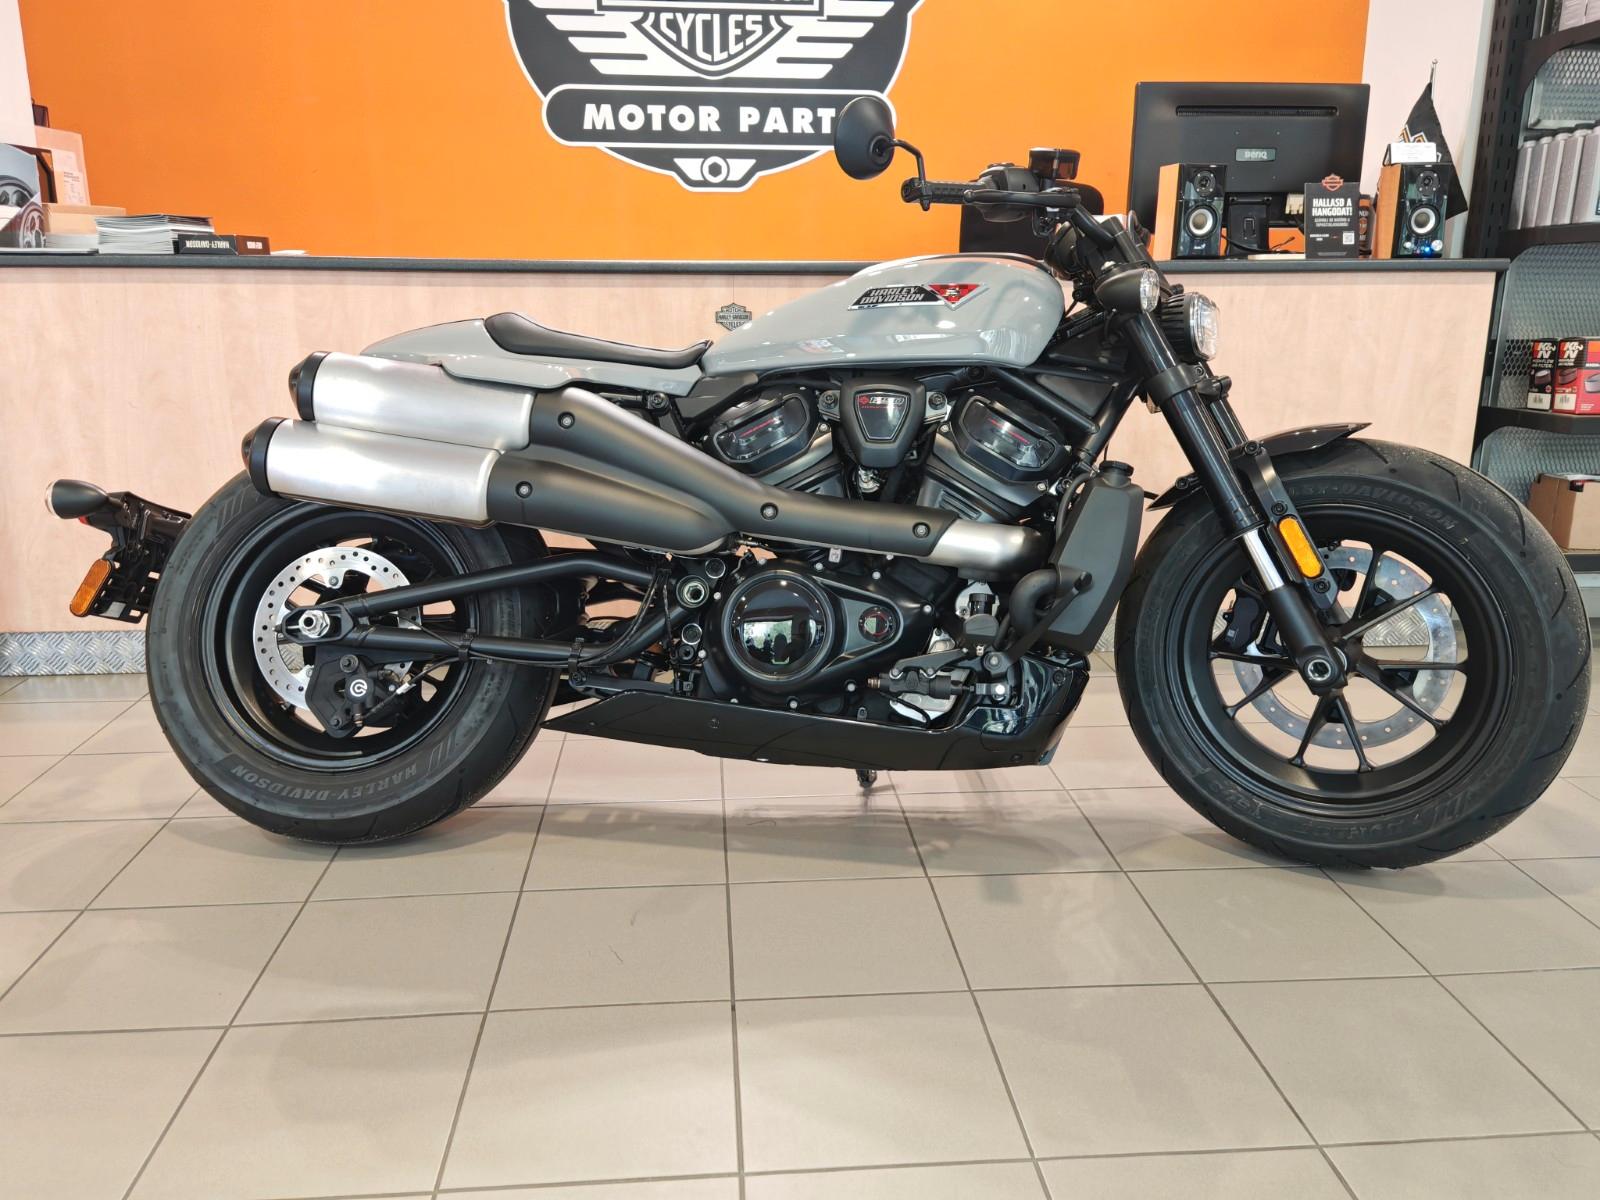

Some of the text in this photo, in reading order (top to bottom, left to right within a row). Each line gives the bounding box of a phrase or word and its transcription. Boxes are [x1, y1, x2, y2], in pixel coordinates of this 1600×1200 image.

[660, 12, 763, 62] CYCLES
[583, 103, 836, 134] MOTOR PART
[1313, 198, 1352, 207] HALLASD A
[1312, 207, 1353, 216] HANGODAT!
[870, 287, 917, 297] HARLEY
[860, 293, 924, 304] DAVIDSON
[230, 763, 418, 801] HARLEY-DAVIDSON
